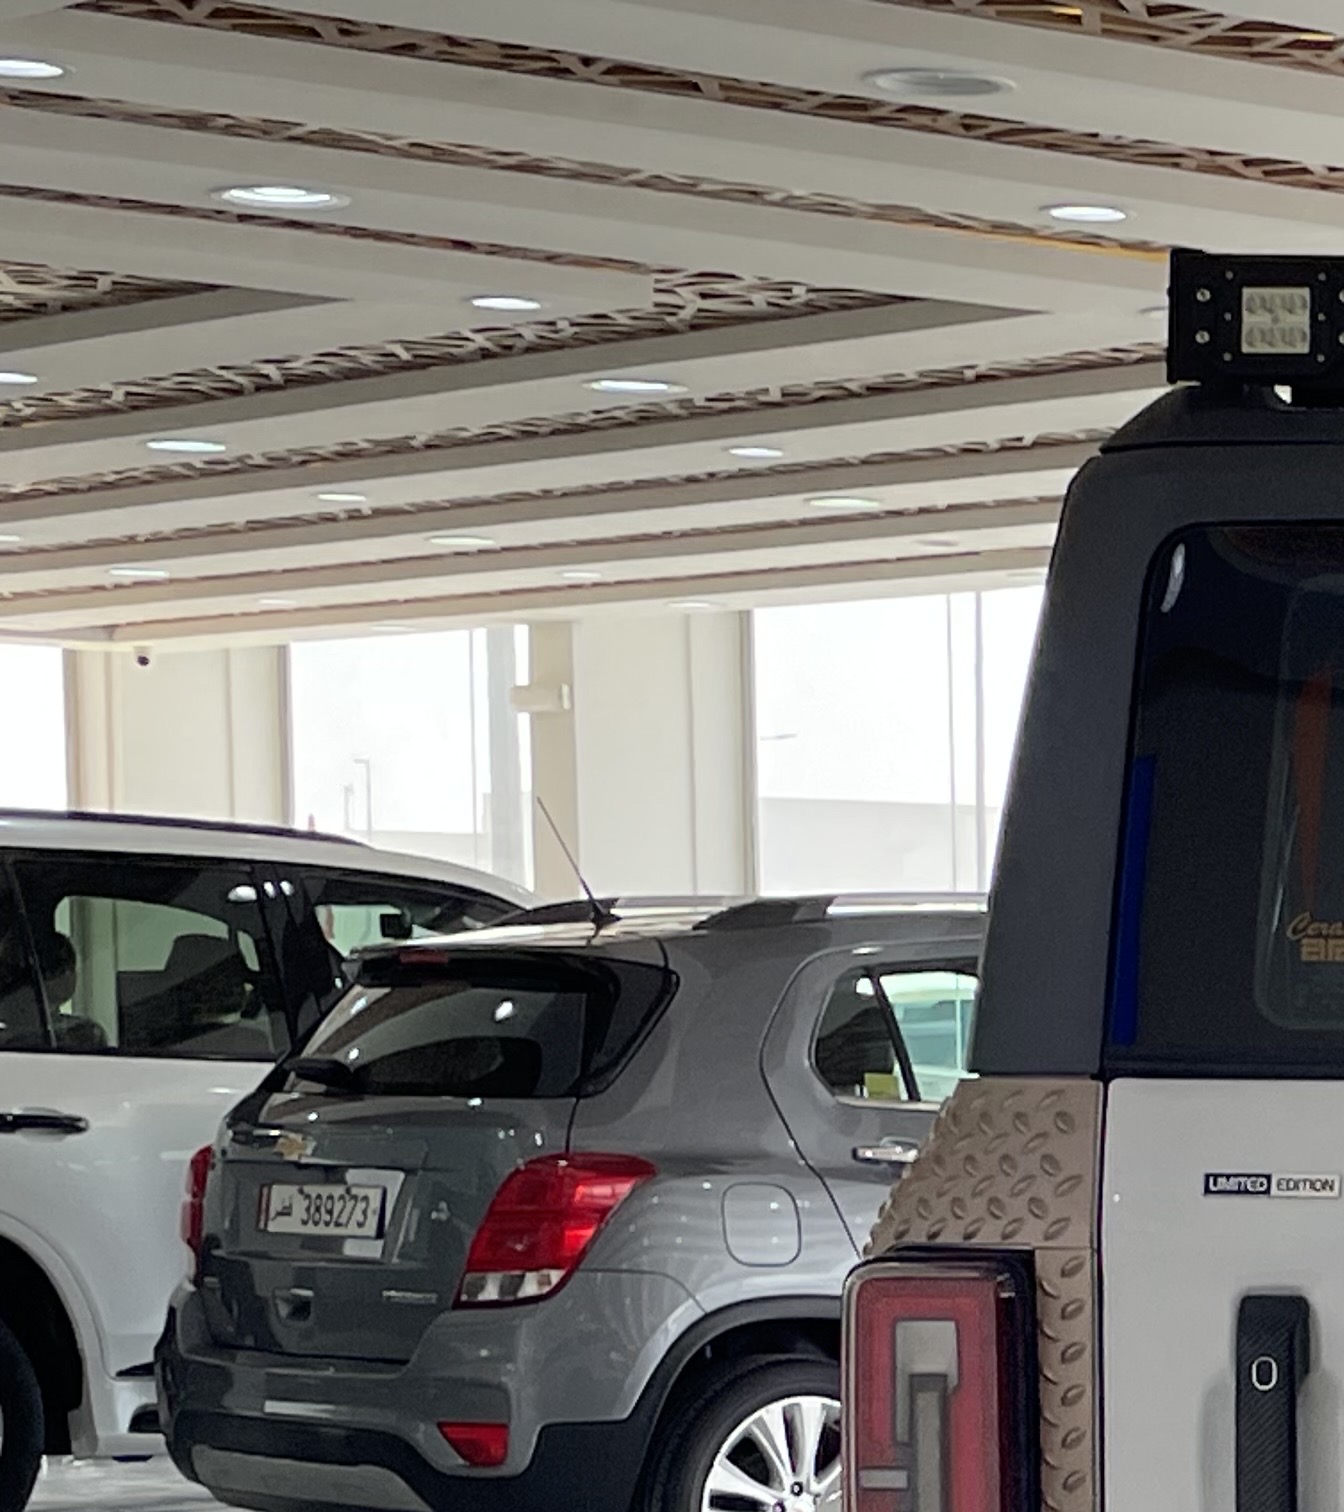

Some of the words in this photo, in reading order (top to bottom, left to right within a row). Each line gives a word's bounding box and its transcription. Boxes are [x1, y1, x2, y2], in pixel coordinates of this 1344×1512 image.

[1208, 1176, 1268, 1192] LIMITED
[1276, 1178, 1335, 1193] EDITION
[300, 1192, 370, 1229] 389273
